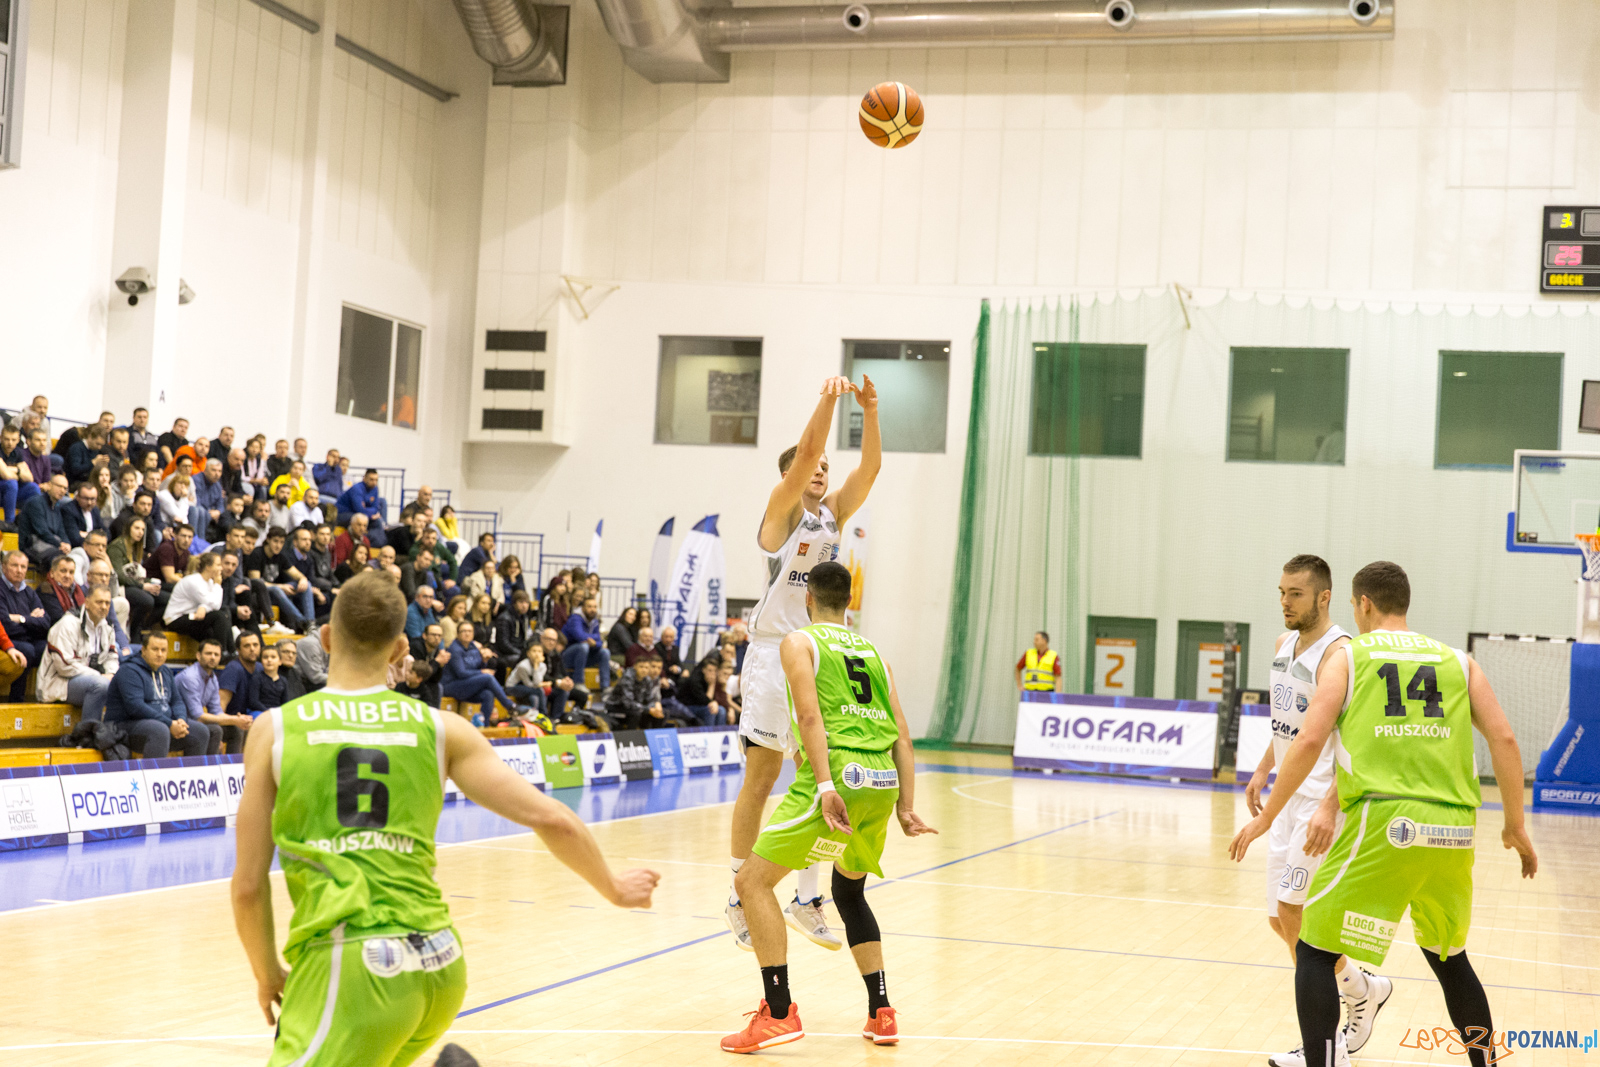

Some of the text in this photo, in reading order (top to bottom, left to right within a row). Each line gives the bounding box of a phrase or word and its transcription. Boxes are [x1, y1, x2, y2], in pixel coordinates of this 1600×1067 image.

[1554, 245, 1582, 266] 25
[1549, 272, 1584, 286] GOŚCIE
[1359, 634, 1443, 651] UNIBEN
[843, 655, 873, 704] 5
[1105, 653, 1125, 688] 2
[1376, 662, 1444, 718] 14
[297, 700, 424, 723] UNIBEN
[1041, 716, 1184, 746] BIOFARM
[1374, 723, 1451, 739] PRUSZKÓW
[152, 779, 220, 802] BIOFARM
[337, 747, 389, 829] 6
[8, 810, 37, 825] HOTEL
[1280, 864, 1309, 891] 20
[1347, 915, 1375, 932] LOGO
